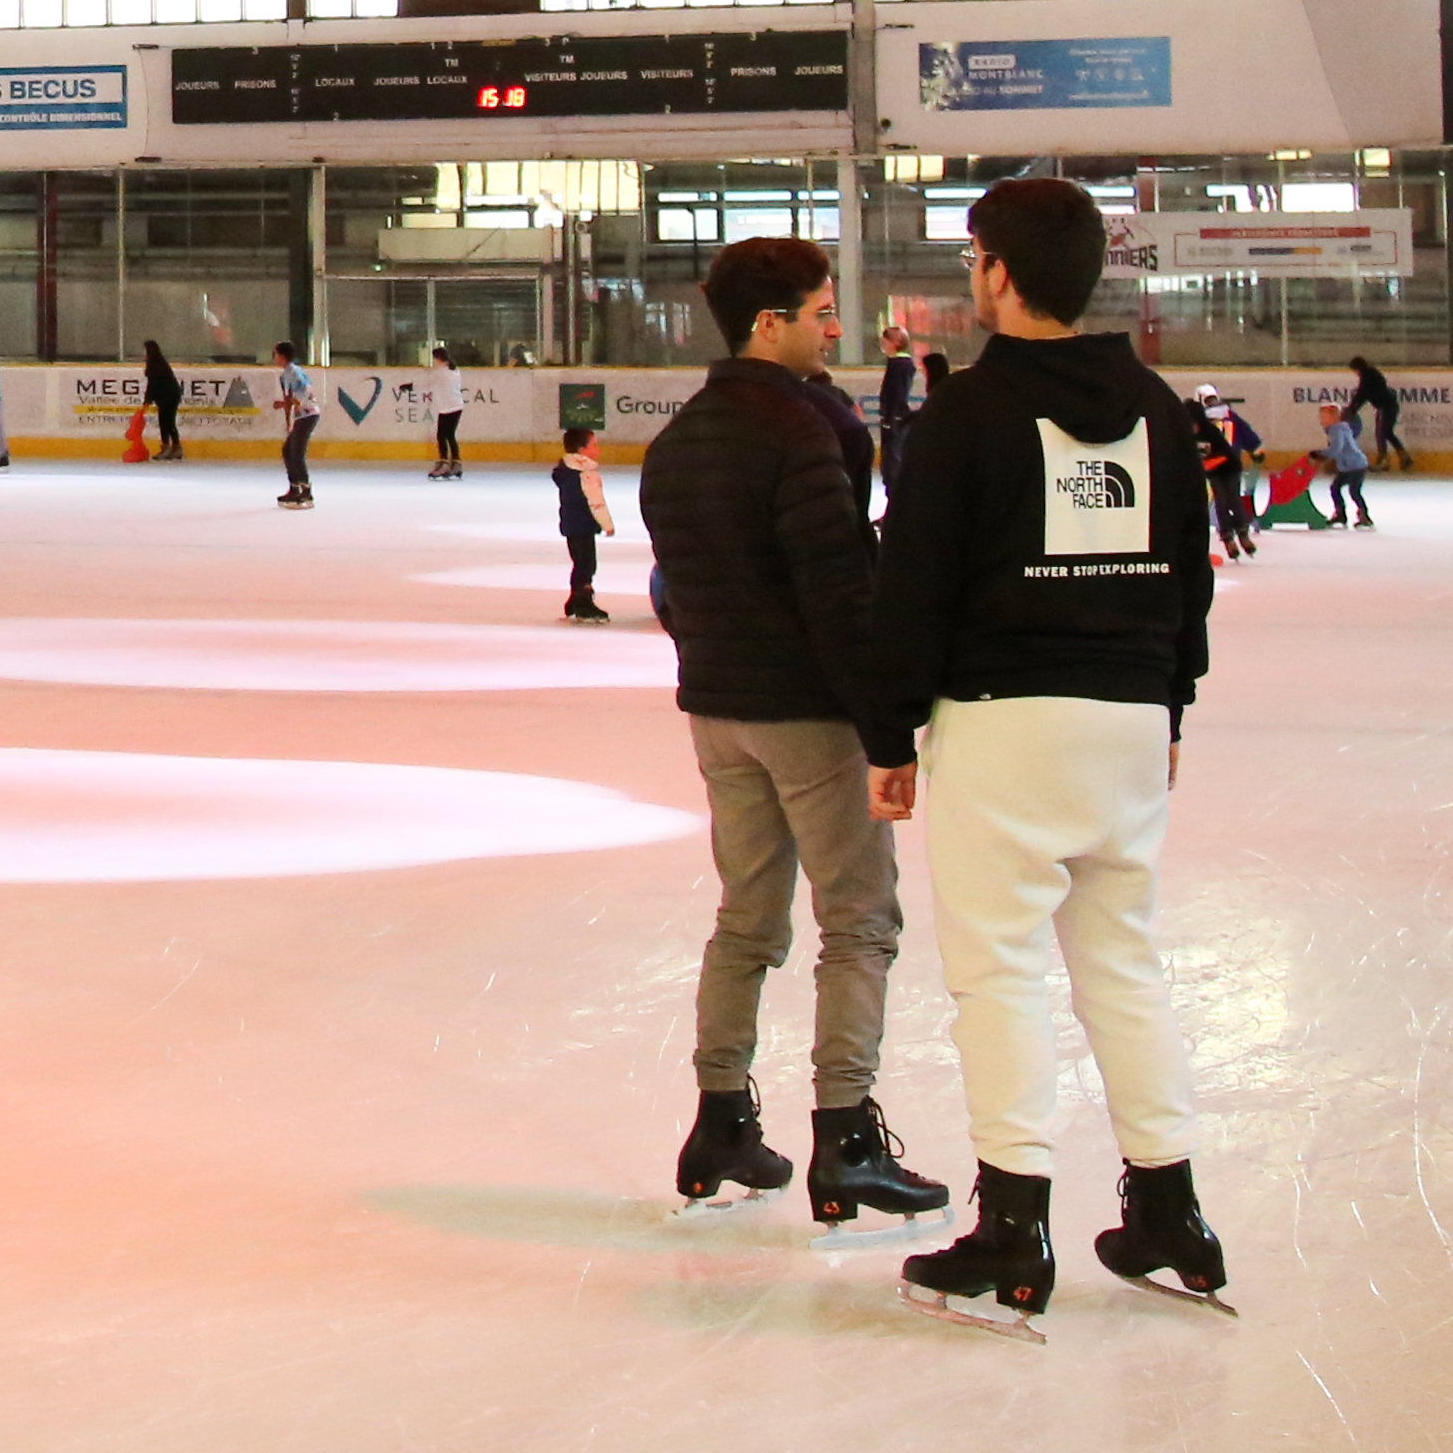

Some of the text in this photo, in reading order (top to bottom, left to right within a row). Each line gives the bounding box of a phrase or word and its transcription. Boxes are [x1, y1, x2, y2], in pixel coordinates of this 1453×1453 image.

[445, 59, 459, 67] TM
[560, 55, 574, 64] TM
[175, 65, 843, 91] JOUEURS PRISONS LOCAUX JOUEURS LOCAUX VISITEURS JOUEURS VISITEURS PRISONS JOUEURS
[9, 78, 96, 99] BECUS
[76, 379, 226, 396] MEGET
[1076, 461, 1103, 476] THE
[1056, 477, 1104, 493] NORTH
[1072, 493, 1104, 509] FACE
[1024, 562, 1171, 578] NEVER STOP EXPLORING
